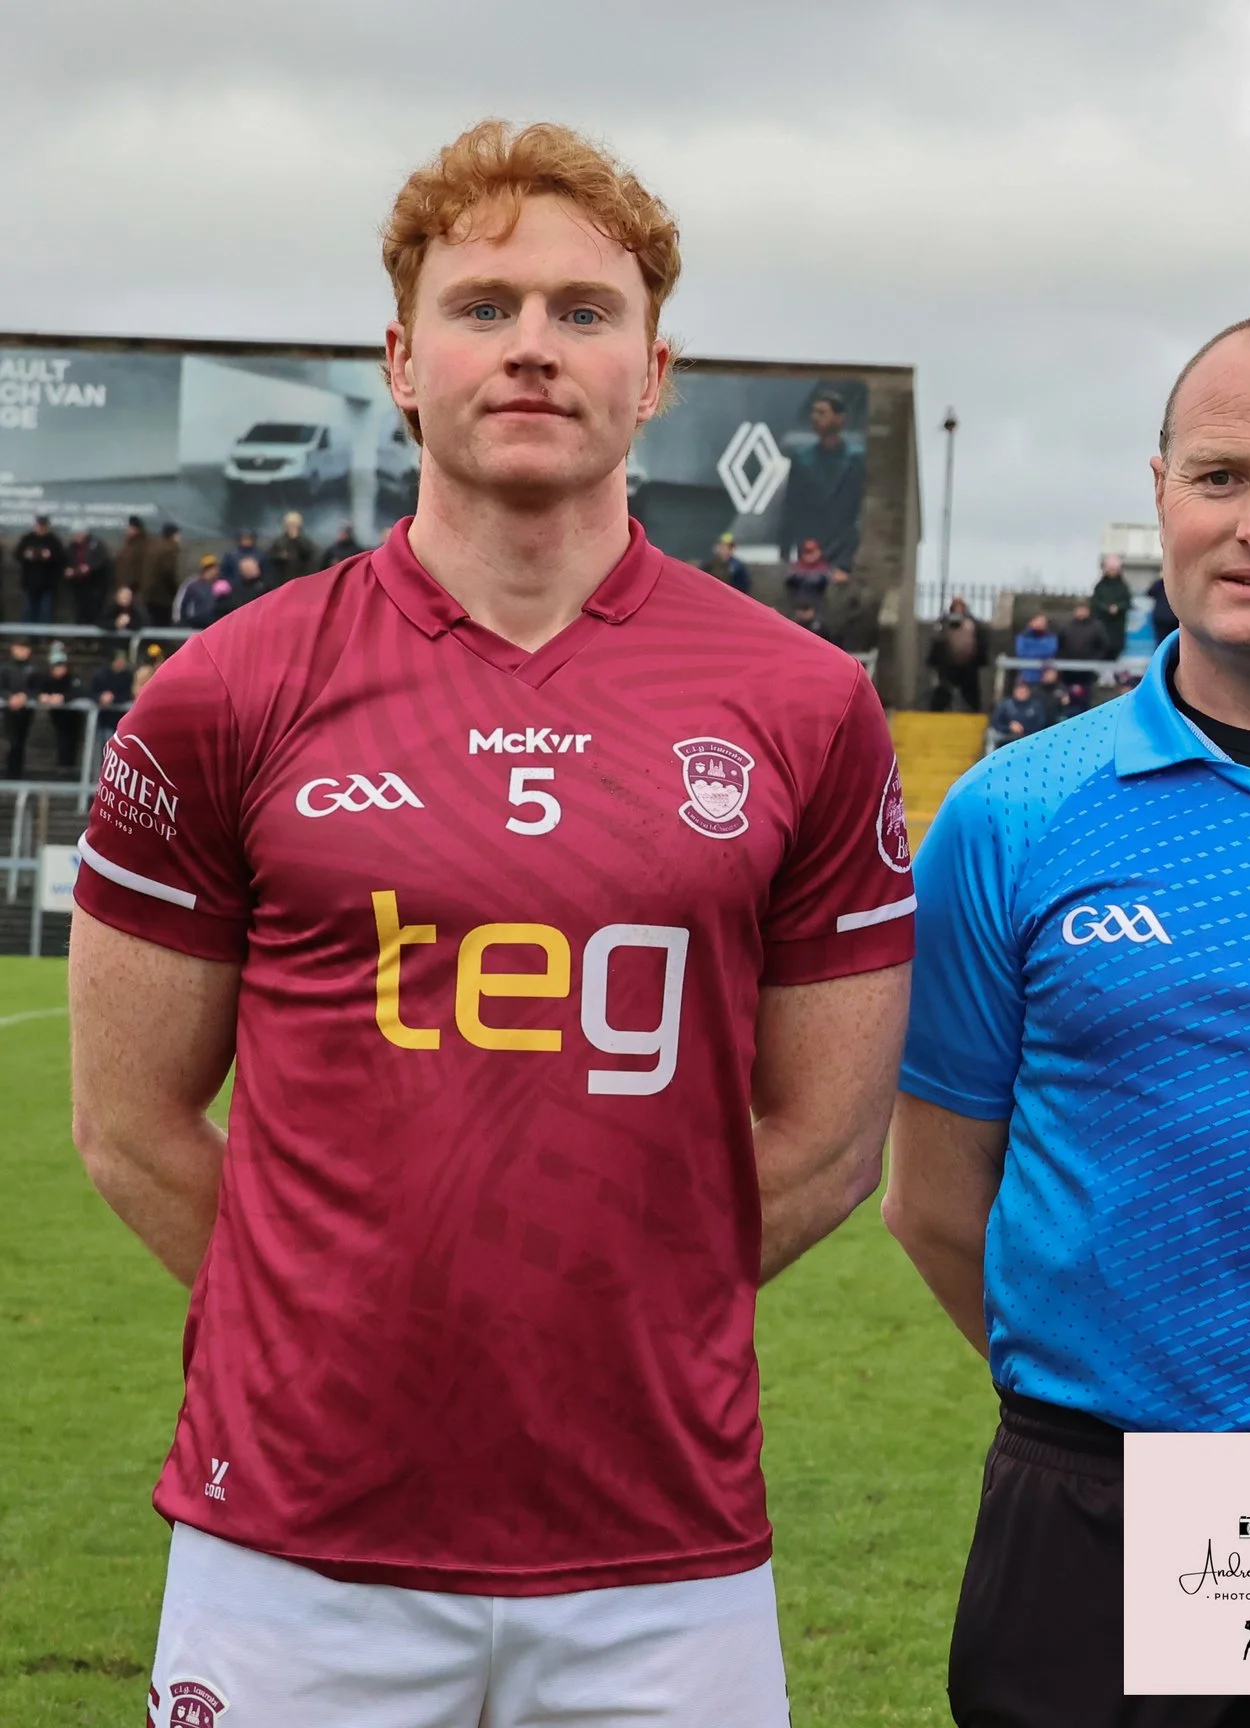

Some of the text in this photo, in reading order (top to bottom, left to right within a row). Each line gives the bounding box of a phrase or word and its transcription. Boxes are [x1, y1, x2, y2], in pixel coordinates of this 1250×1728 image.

[45, 382, 107, 407] VAN
[505, 767, 562, 836] 5
[115, 819, 133, 835] 1963
[118, 800, 177, 841] GROUP
[371, 889, 690, 1096] teg
[204, 1482, 226, 1501] COOL
